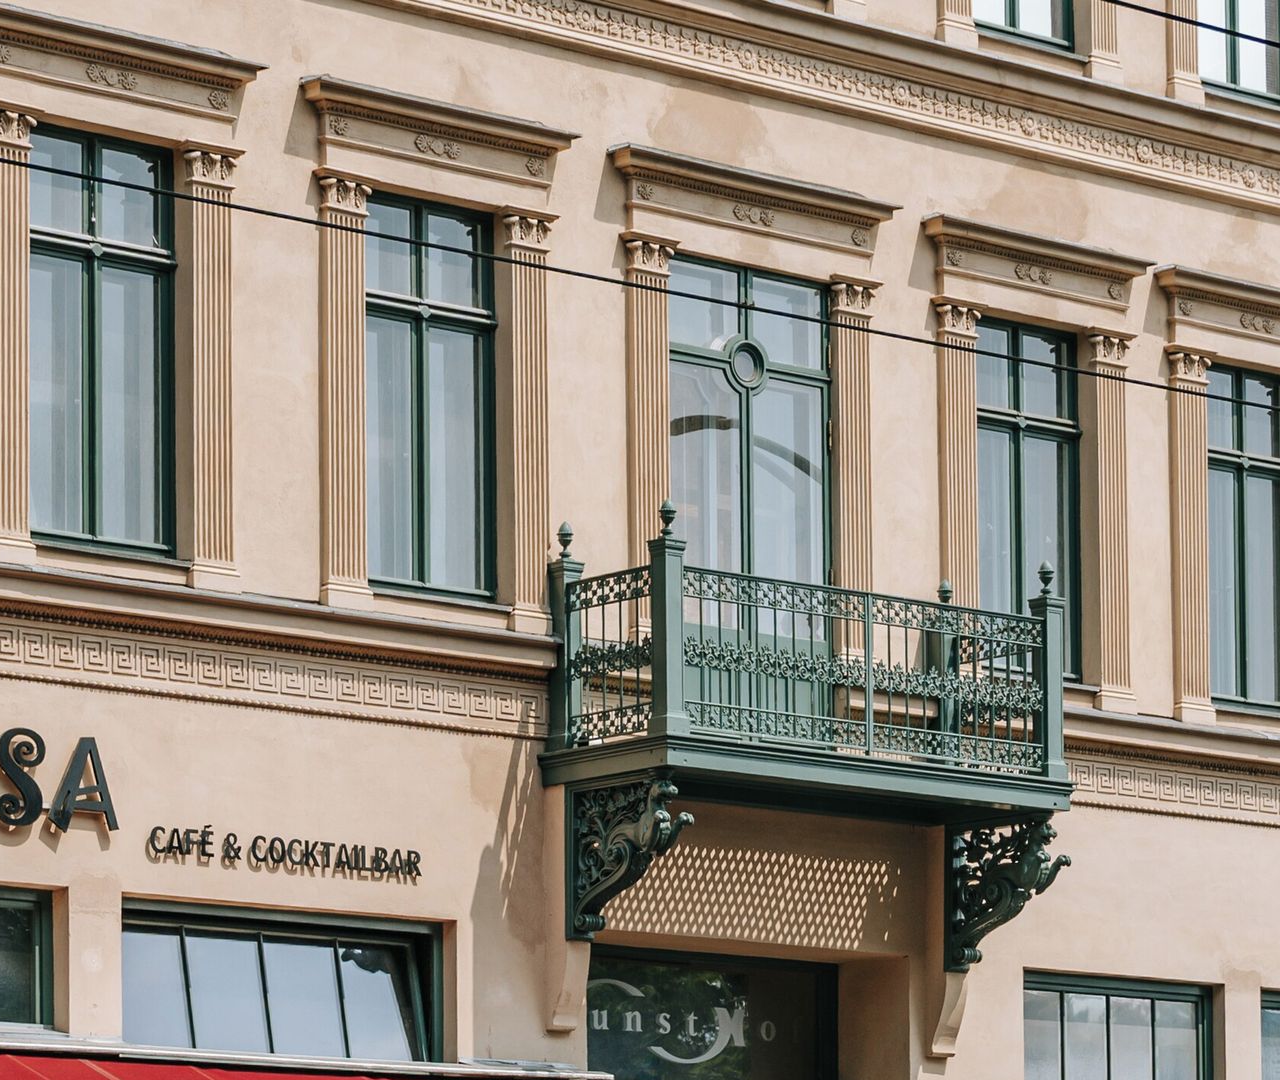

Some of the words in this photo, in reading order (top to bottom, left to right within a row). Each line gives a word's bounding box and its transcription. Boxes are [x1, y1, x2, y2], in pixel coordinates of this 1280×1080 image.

[149, 825, 215, 858] CAFÉ
[225, 833, 242, 861] &
[252, 836, 422, 877] COCKTAILBAR
